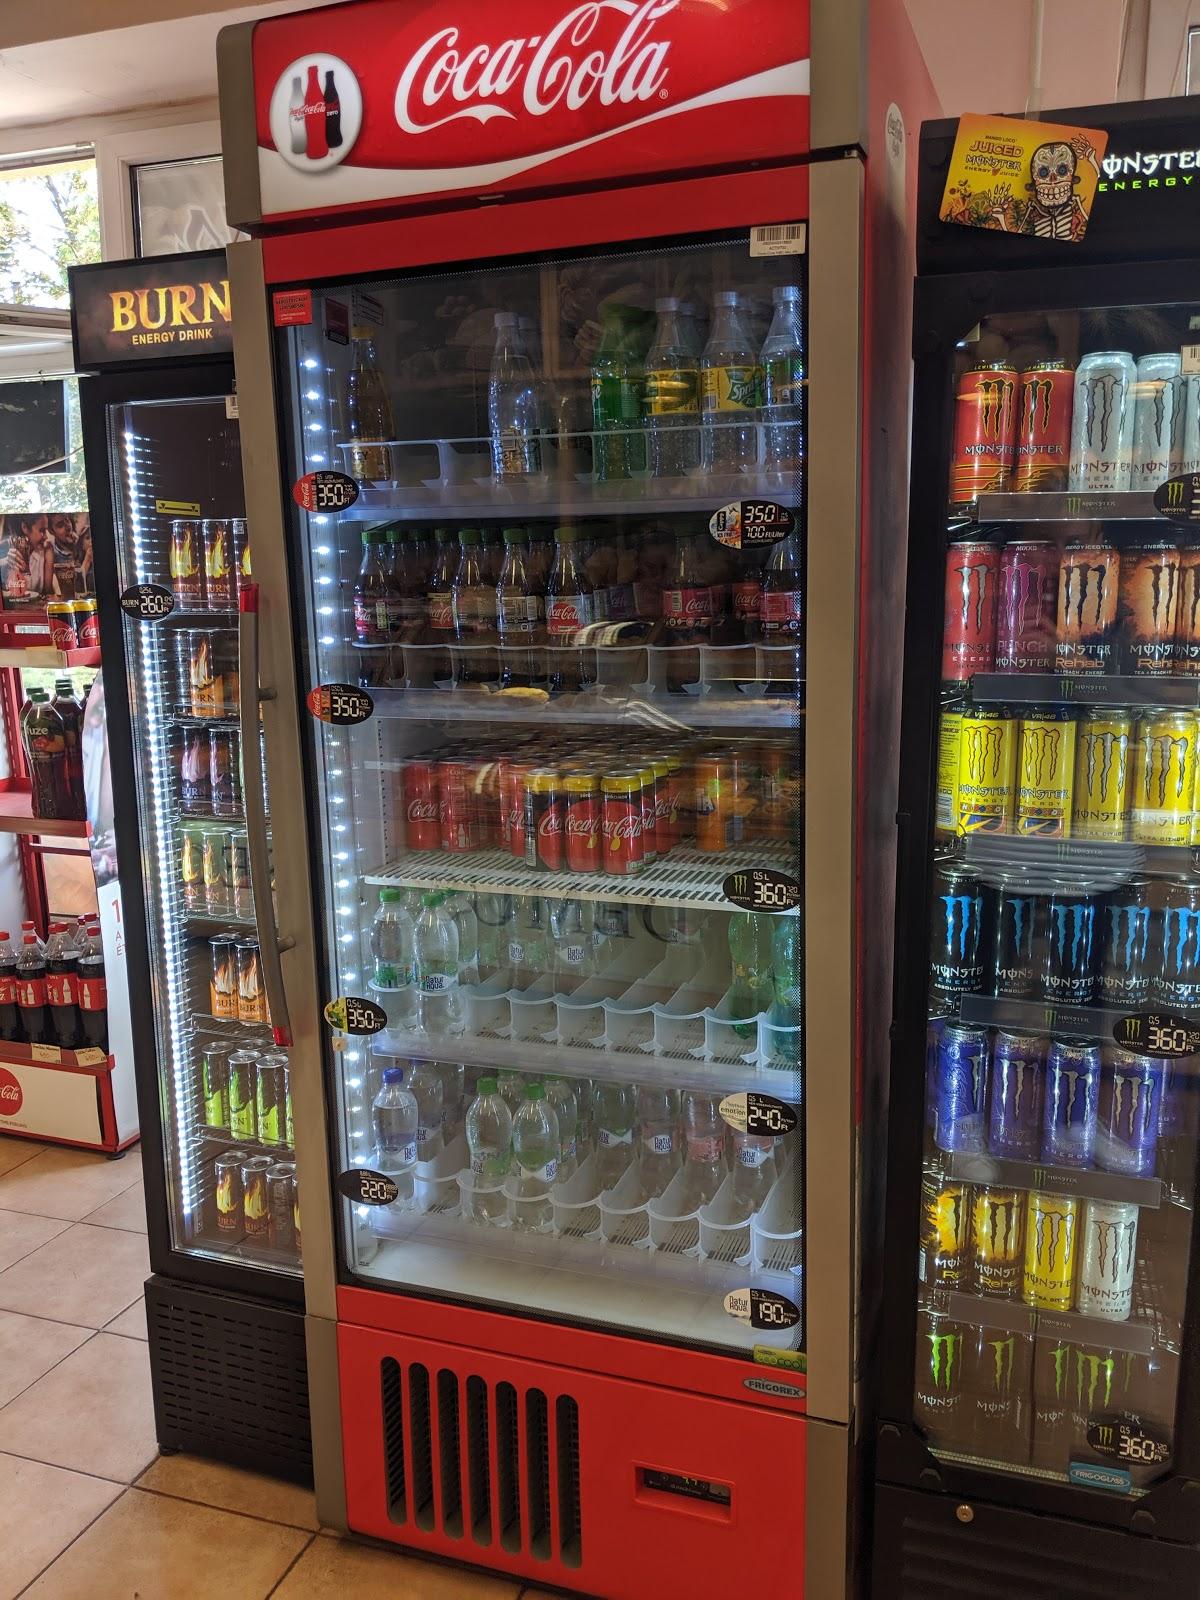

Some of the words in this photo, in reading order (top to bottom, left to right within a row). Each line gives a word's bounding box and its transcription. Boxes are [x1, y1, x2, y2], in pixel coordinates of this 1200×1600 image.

[394, 0, 681, 134] Coca-Cola
[969, 140, 1023, 157] JUICED
[966, 154, 1022, 170] MONSTER
[1098, 176, 1193, 192] ENERGY
[132, 331, 175, 346] ENERGY
[179, 328, 213, 341] DRINK
[318, 484, 344, 506] 350
[744, 504, 776, 523] 350
[745, 526, 765, 538] 700
[140, 595, 163, 613] 260
[332, 696, 359, 717] 350
[754, 881, 786, 905] 360
[348, 1009, 374, 1029] 350
[1148, 1027, 1186, 1052] 360
[720, 1108, 746, 1116] emotion
[748, 1106, 781, 1130] 240
[361, 1180, 387, 1200] 220
[729, 1296, 748, 1306] Natur
[759, 1302, 784, 1323] 190
[749, 1380, 800, 1397] FRIGOREX
[1119, 1435, 1154, 1460] 360
[1075, 1470, 1125, 1485] FRIGOGLASS
